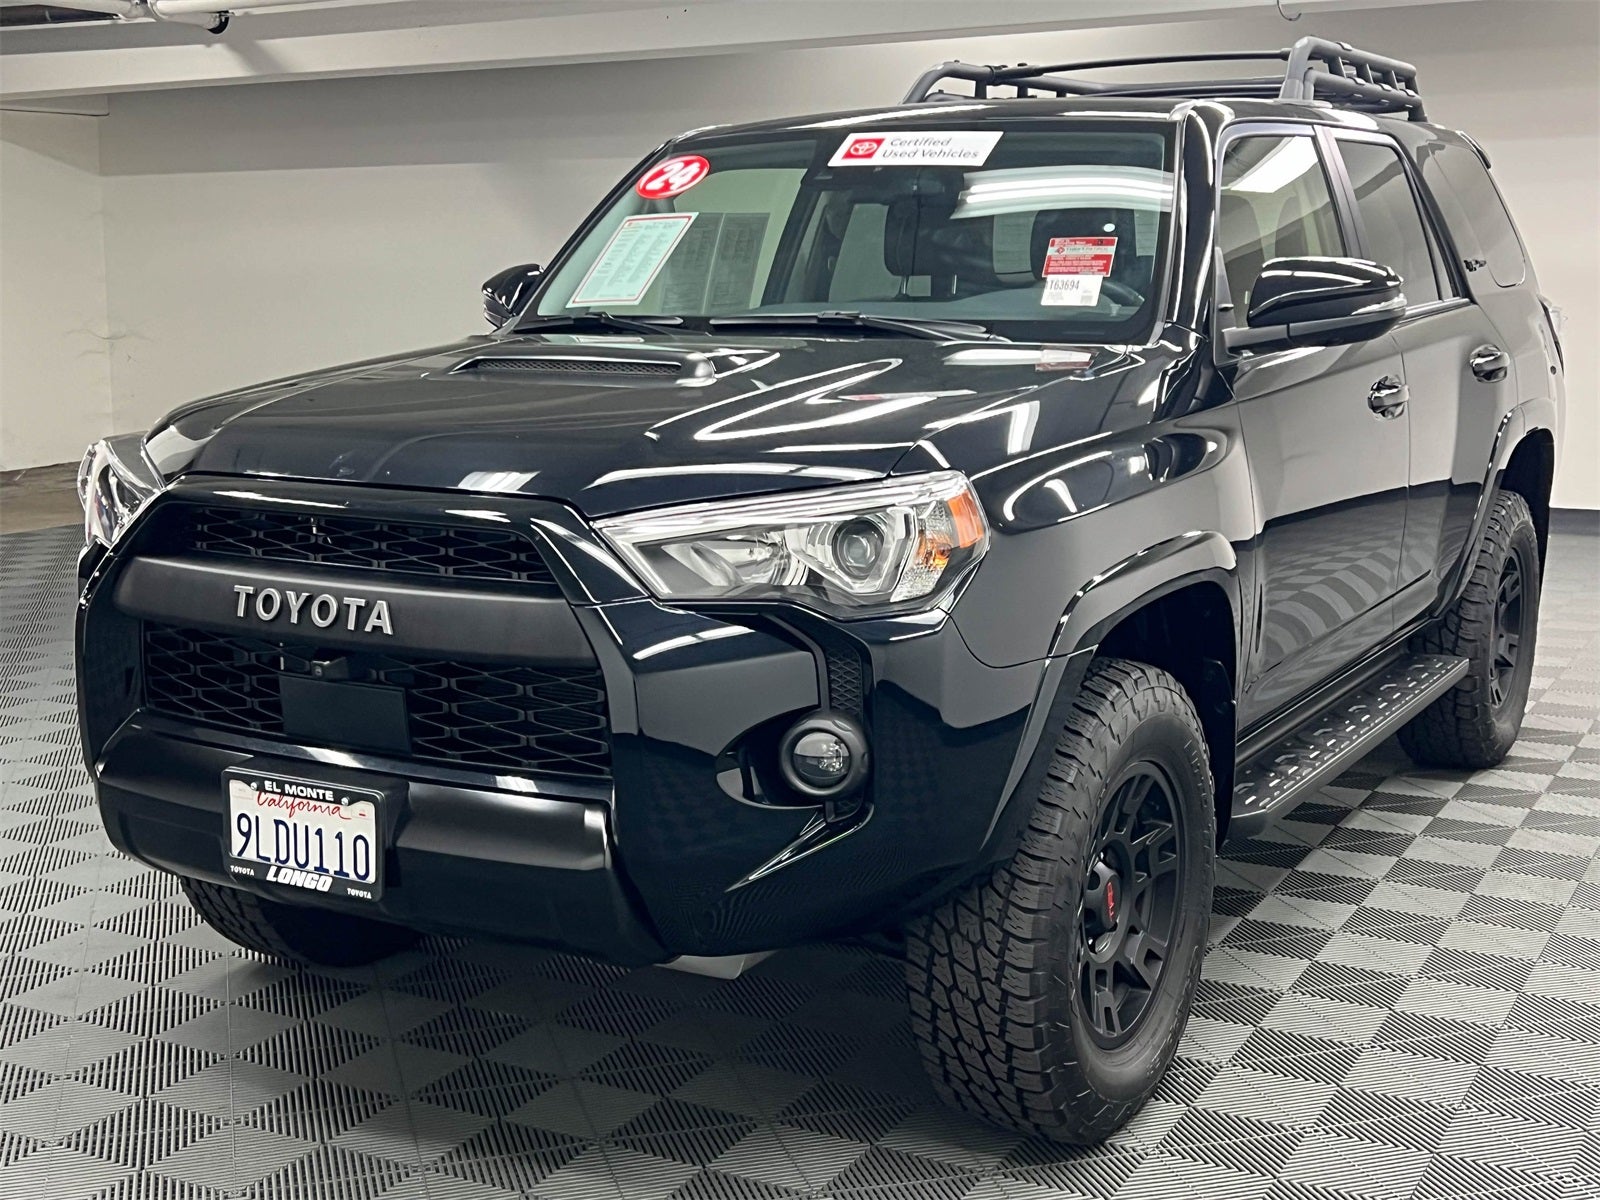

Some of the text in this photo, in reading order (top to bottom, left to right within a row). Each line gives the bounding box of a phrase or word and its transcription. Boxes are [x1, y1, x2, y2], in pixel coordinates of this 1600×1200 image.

[882, 148, 980, 158] Used Vehicles
[890, 137, 953, 147] Certified
[645, 161, 701, 192] 24
[233, 584, 394, 636] TOYOTA
[256, 790, 352, 821] California
[264, 780, 335, 802] EL MONTE
[236, 812, 371, 881] 9LDU110
[230, 865, 373, 900] TOYOTA LONGO TOYOTA
